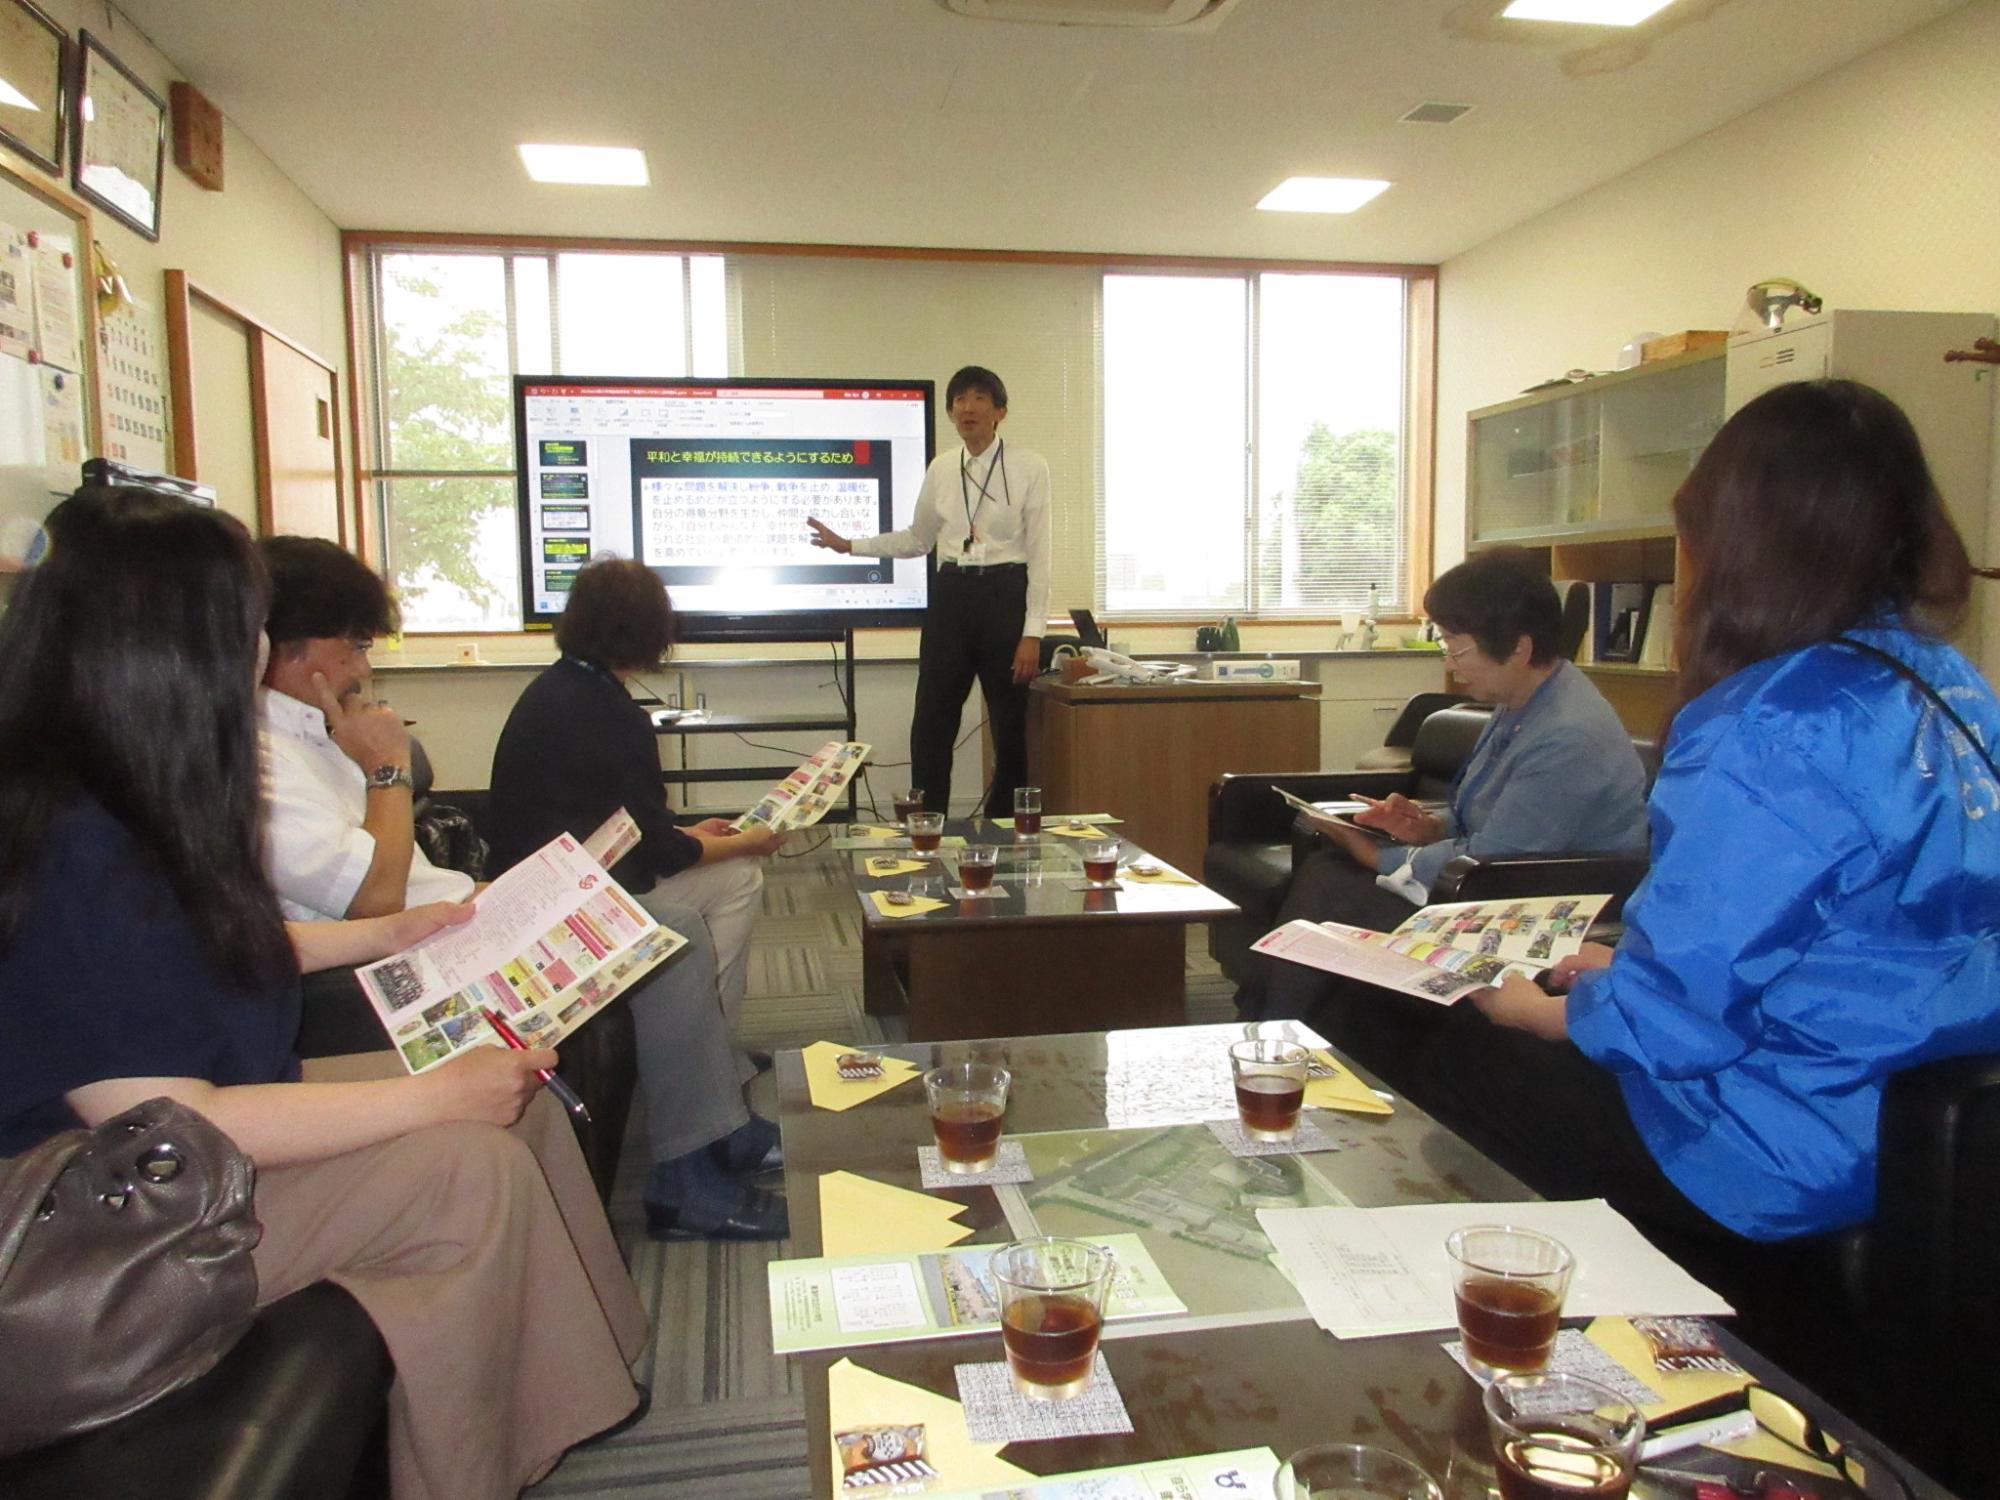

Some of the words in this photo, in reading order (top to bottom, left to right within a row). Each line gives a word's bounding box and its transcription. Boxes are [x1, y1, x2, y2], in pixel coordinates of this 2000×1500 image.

[646, 449, 854, 464] 平和と幸福が持続できるようにするため
